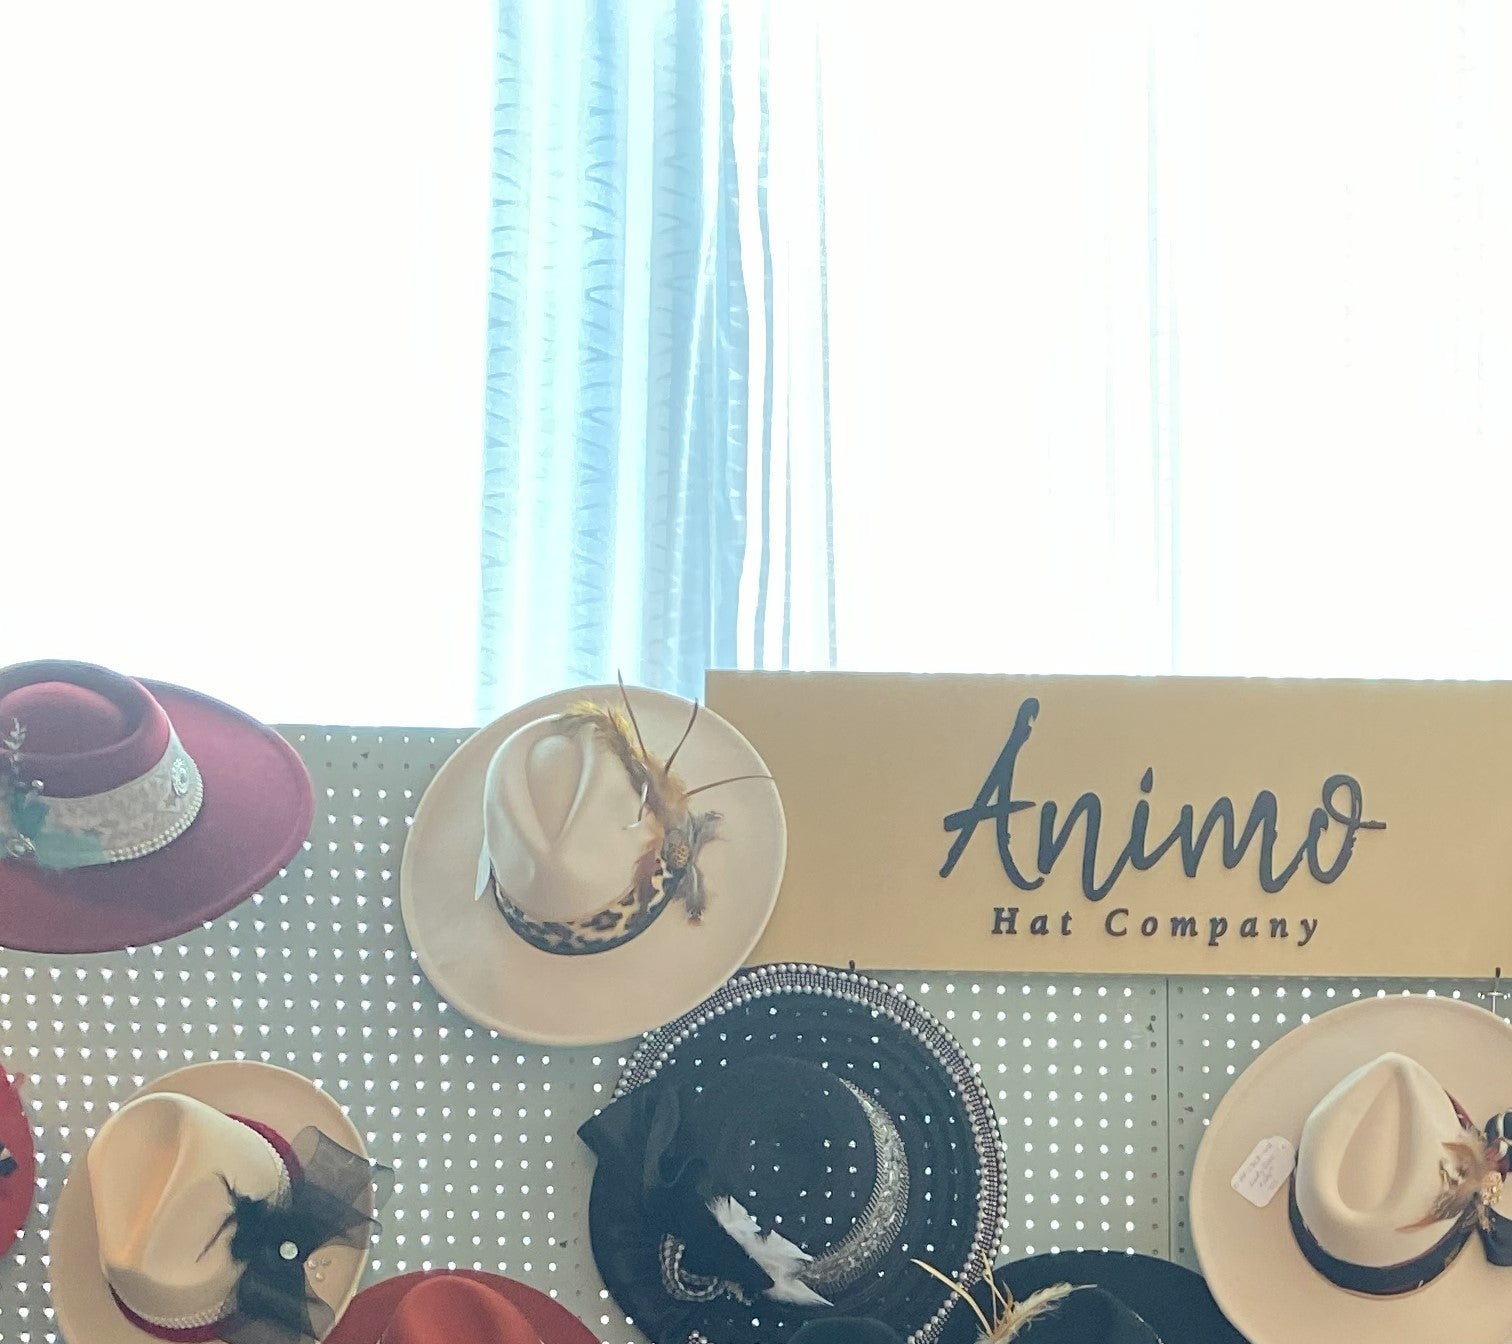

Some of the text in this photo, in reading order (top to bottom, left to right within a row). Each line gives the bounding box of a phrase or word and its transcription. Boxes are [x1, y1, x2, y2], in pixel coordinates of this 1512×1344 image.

[939, 697, 1387, 902] Animo
[991, 907, 1323, 946] Hat Company
